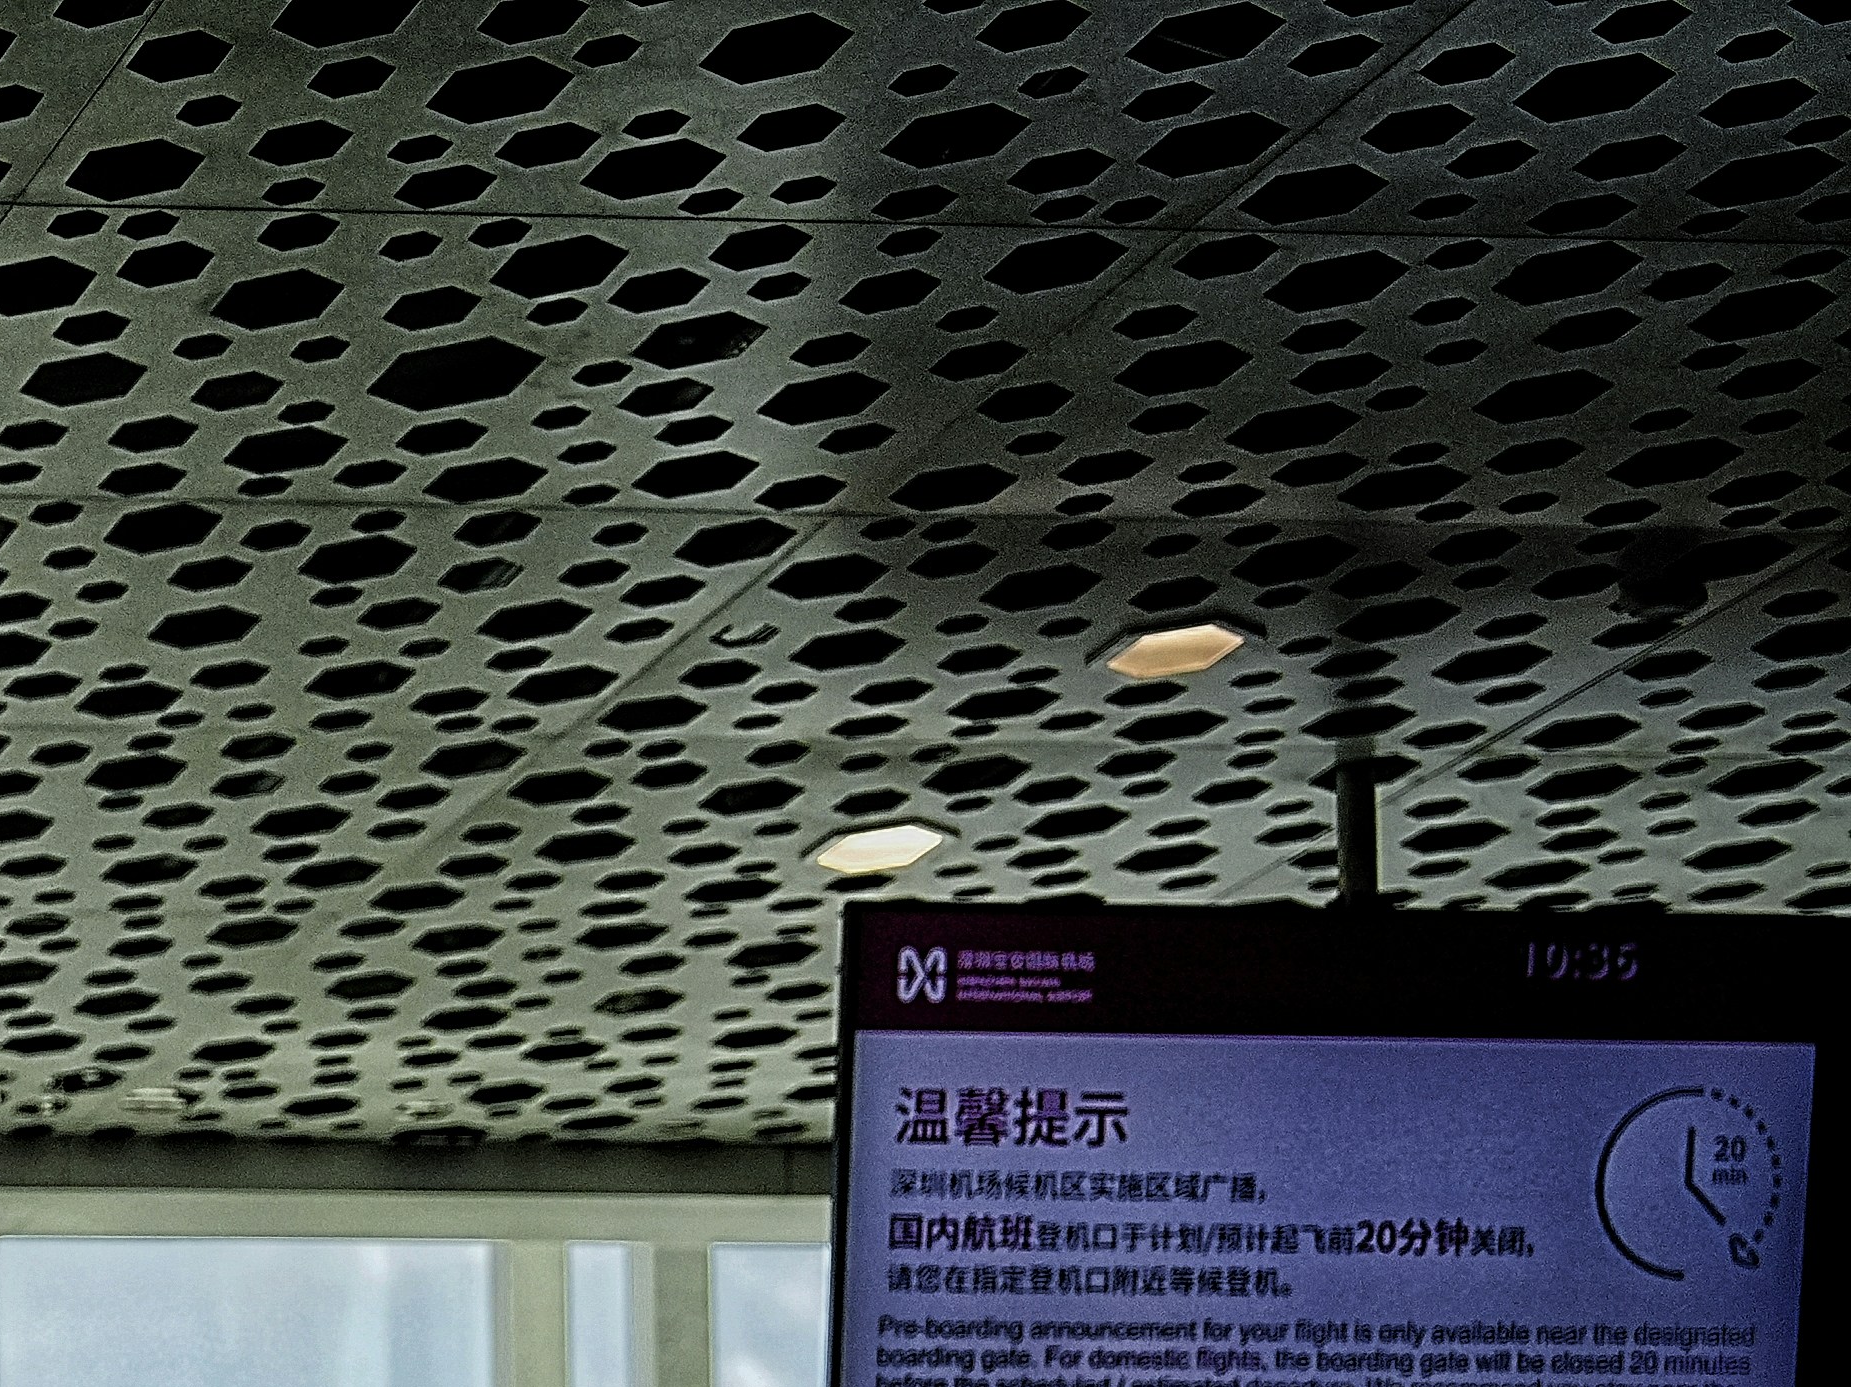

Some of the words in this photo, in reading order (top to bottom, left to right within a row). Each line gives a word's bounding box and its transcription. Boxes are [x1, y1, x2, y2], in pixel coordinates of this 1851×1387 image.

[896, 1086, 1129, 1147] 温馨提示
[1713, 1134, 1748, 1163] 20
[1712, 1167, 1748, 1186] min
[877, 1314, 1024, 1344] Pre-boarding
[1030, 1319, 1198, 1341] announcement
[1203, 1317, 1234, 1342] for
[1239, 1322, 1289, 1347] your
[1295, 1318, 1348, 1347] flight
[1354, 1319, 1373, 1343] is
[1378, 1319, 1426, 1348] only
[1432, 1320, 1530, 1345] available
[1536, 1324, 1587, 1345] near
[1592, 1321, 1629, 1346] the
[1633, 1321, 1755, 1351] designated
[876, 1346, 976, 1373] boarding
[1044, 1344, 1082, 1368] For
[1088, 1347, 1191, 1370] domestic
[1274, 1348, 1311, 1371] the
[1316, 1348, 1415, 1377] boarding
[1420, 1351, 1471, 1378] gate
[1476, 1350, 1512, 1373] will
[1517, 1350, 1546, 1374] be
[1552, 1351, 1625, 1375] closed
[1630, 1351, 1660, 1375] 20
[1664, 1351, 1751, 1375] minutes
